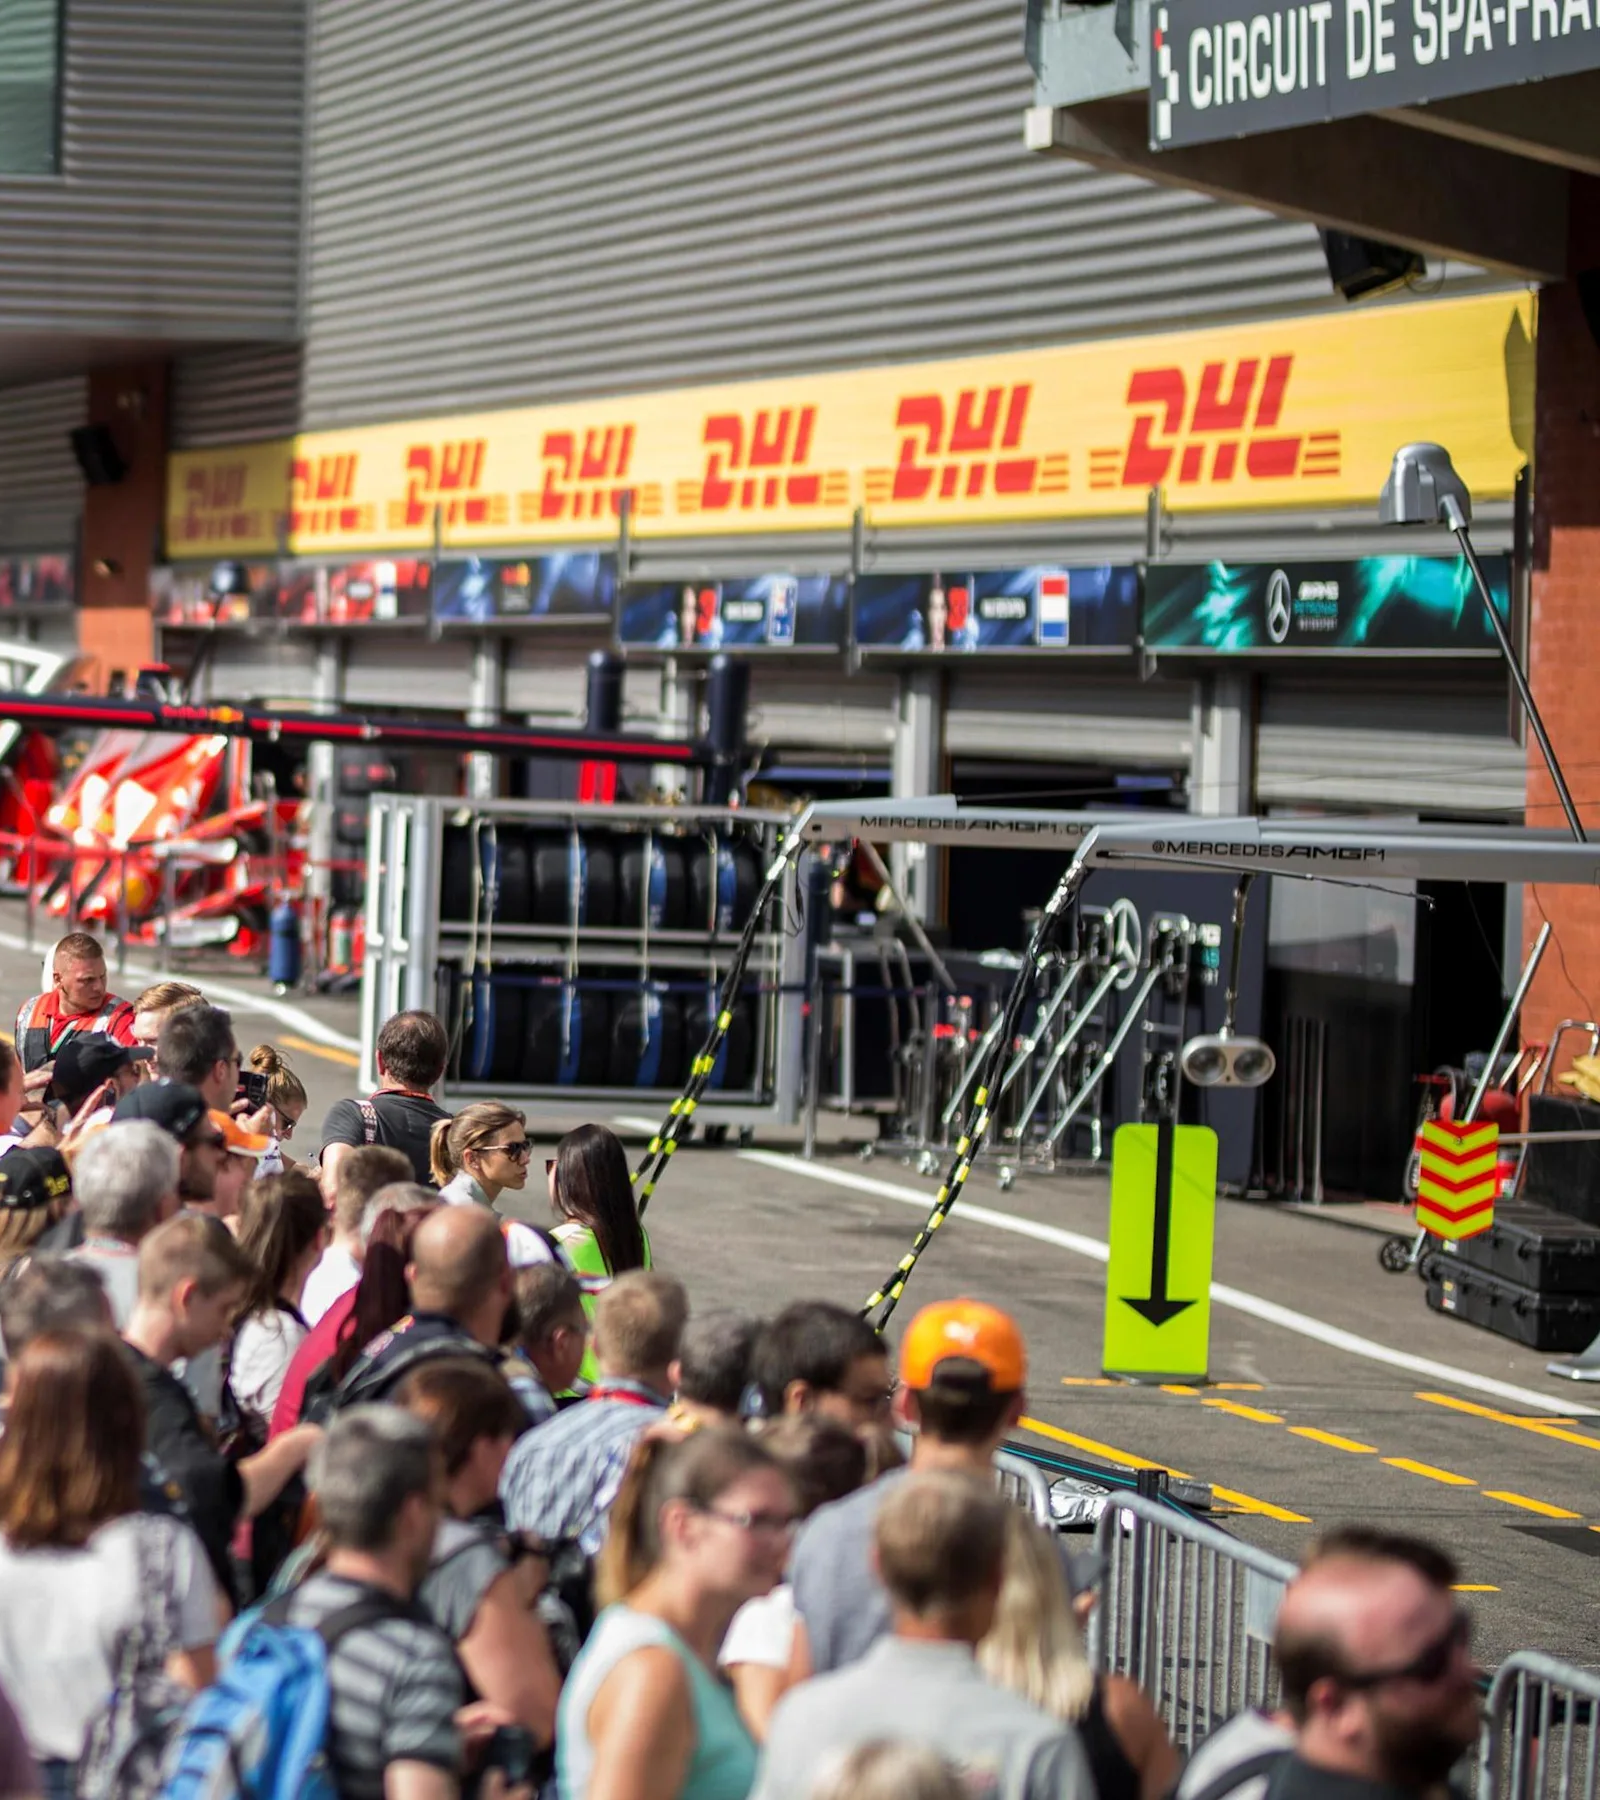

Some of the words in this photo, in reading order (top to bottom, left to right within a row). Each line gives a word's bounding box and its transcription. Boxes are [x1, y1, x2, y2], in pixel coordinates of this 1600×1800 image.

[1188, 1, 1332, 109] CIRCUIT
[1347, 0, 1397, 79] DE
[1412, 0, 1600, 65] SPA-FRA
[404, 438, 490, 528] DHL
[539, 423, 638, 520] DHL
[700, 405, 821, 510] DHL
[891, 382, 1040, 501] DHL
[1121, 354, 1304, 487] DHL
[1152, 839, 1387, 862] @MERCEDESAMGF1
